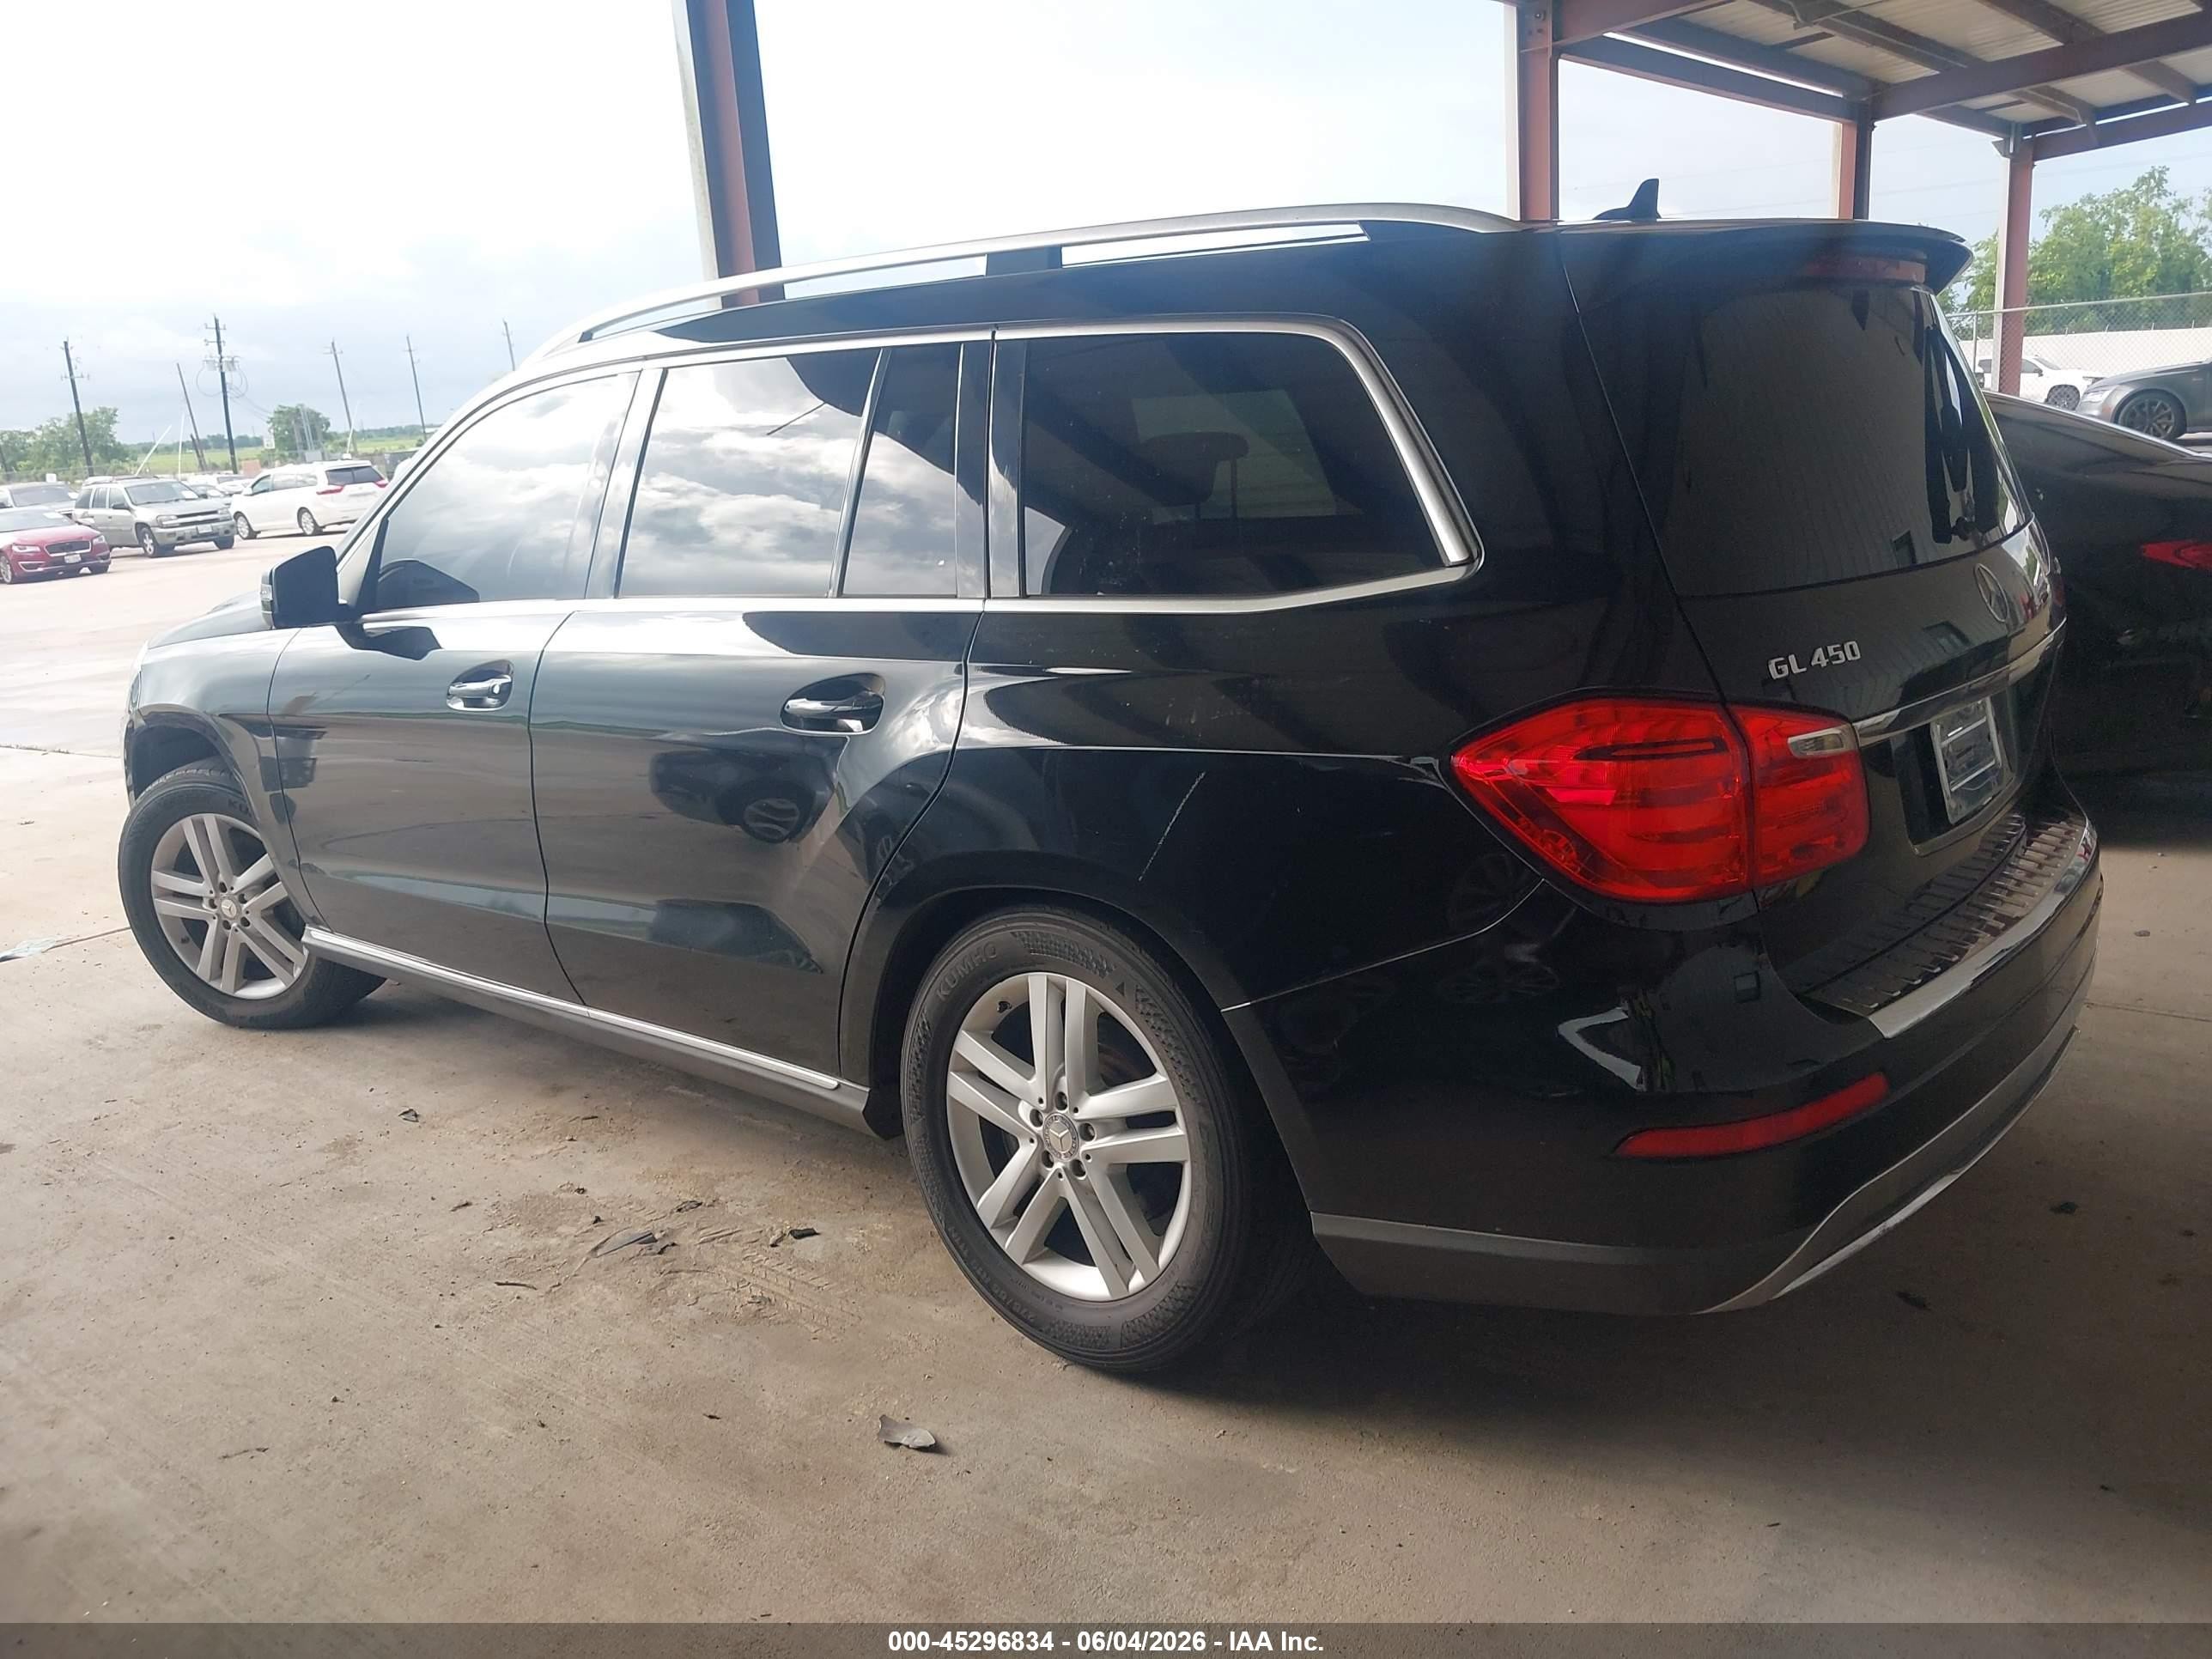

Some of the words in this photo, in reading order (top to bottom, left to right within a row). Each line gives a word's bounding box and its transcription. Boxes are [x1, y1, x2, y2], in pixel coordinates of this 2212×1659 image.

[1768, 653, 1807, 680] GL
[1811, 641, 1861, 667] 450
[937, 941, 997, 1000] KUMHO
